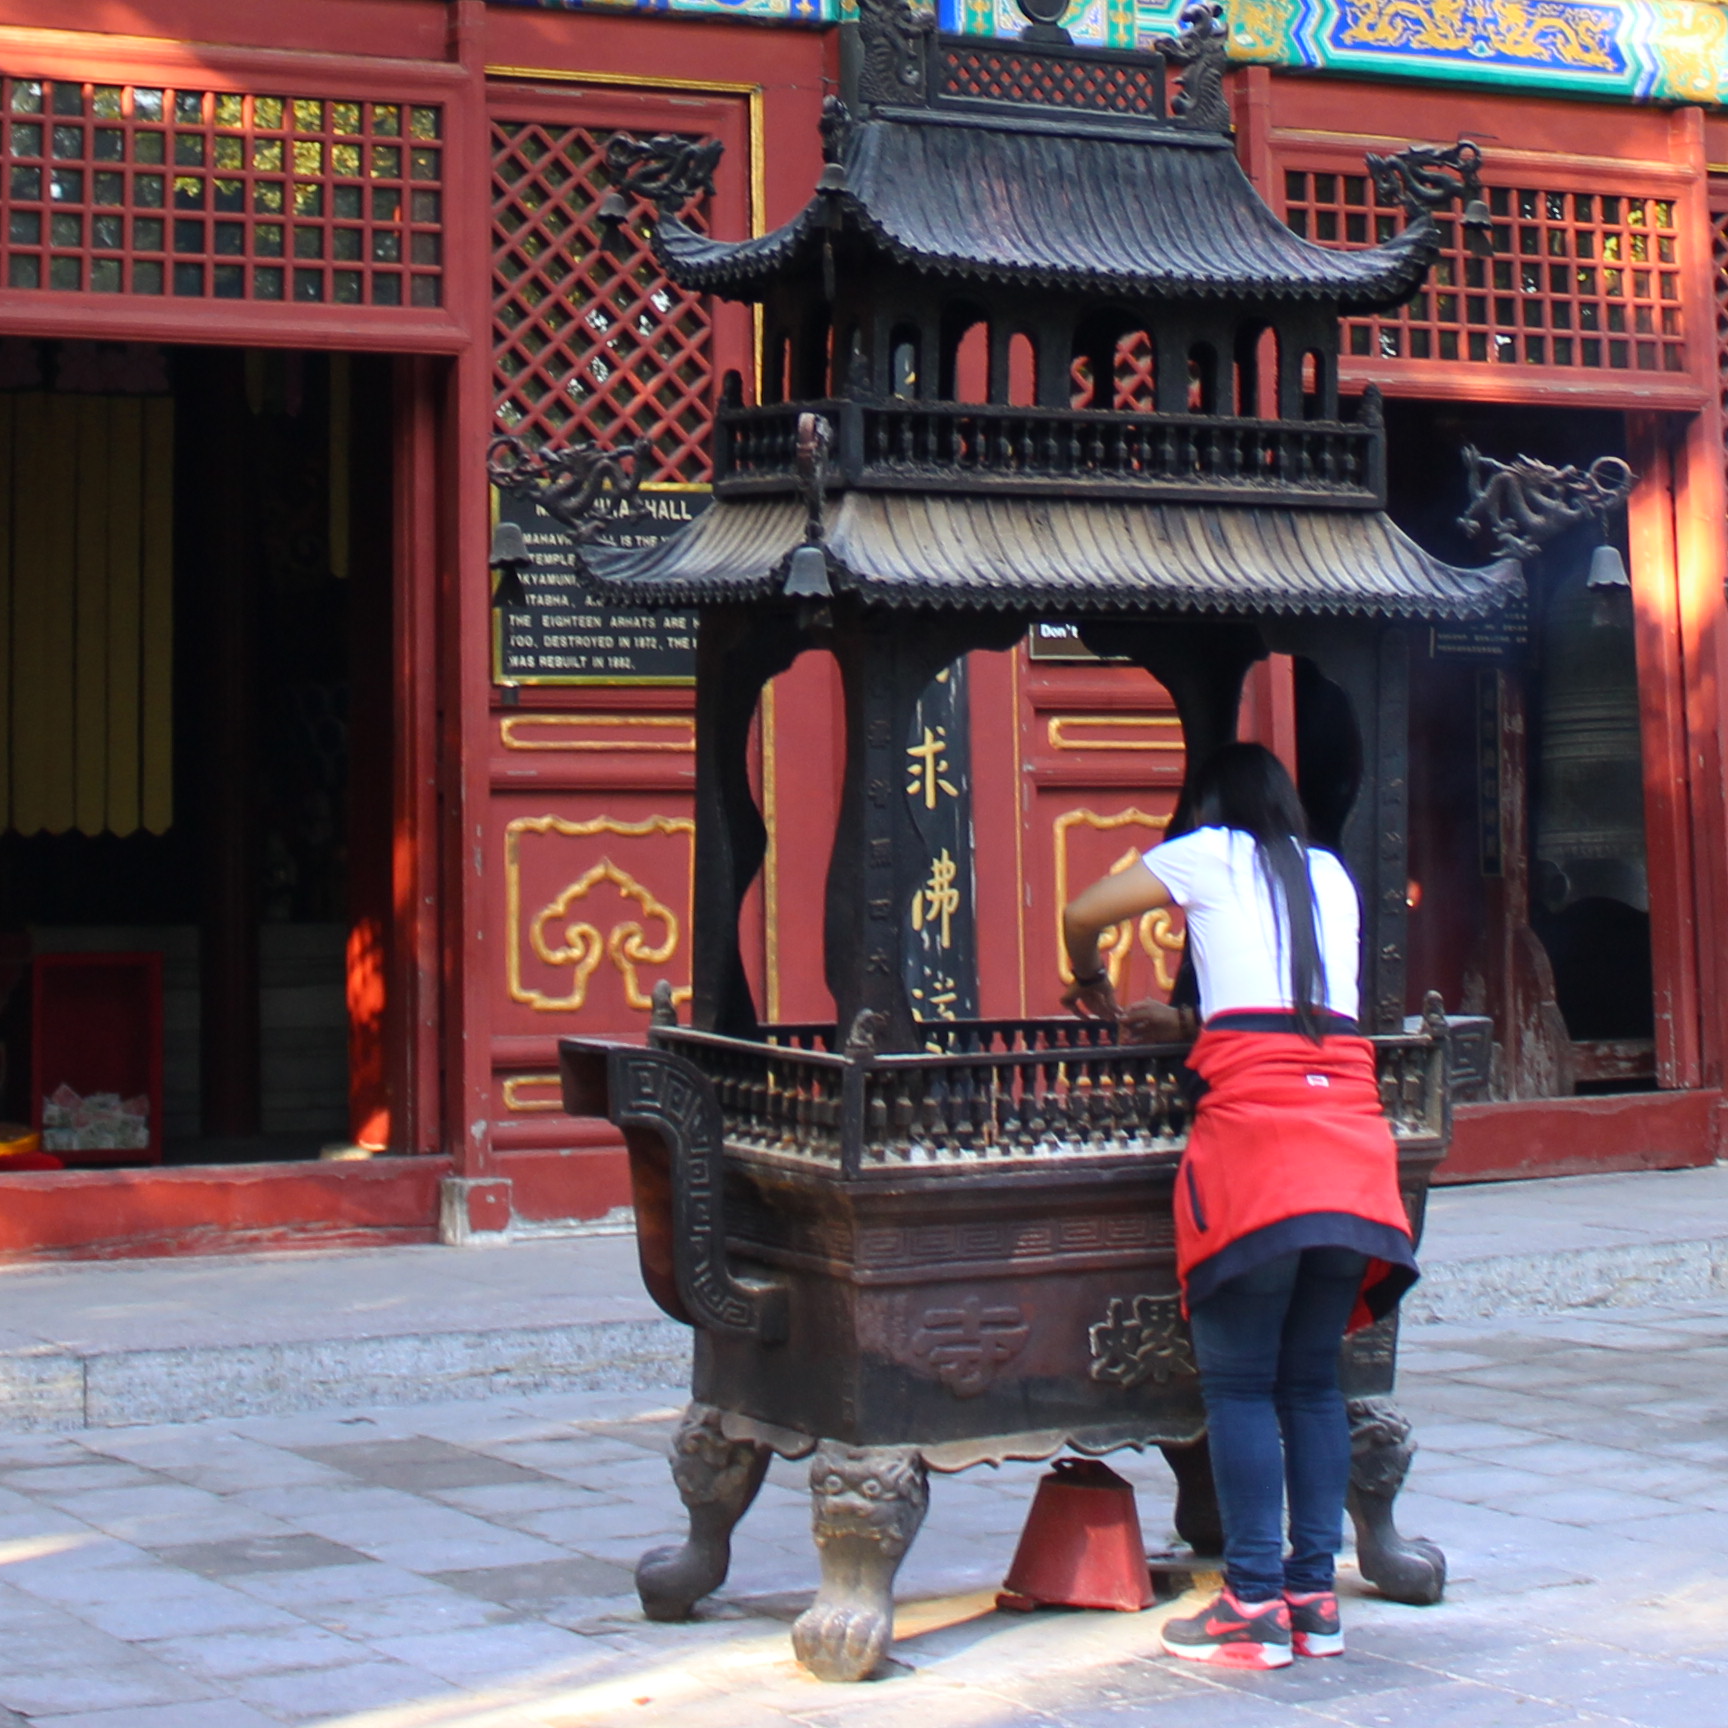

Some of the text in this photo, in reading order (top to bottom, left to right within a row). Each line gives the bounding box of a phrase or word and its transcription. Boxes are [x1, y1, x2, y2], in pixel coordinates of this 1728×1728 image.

[508, 613, 532, 628] THE
[541, 614, 602, 629] EIGHTEEN
[663, 616, 687, 630] ARE
[1040, 623, 1079, 639] Don't
[543, 635, 614, 649] DESTROYED
[618, 635, 631, 649] IN
[667, 636, 691, 650] THE
[508, 655, 536, 669] WAS
[538, 655, 587, 669] REBUILT
[591, 656, 604, 670] IN
